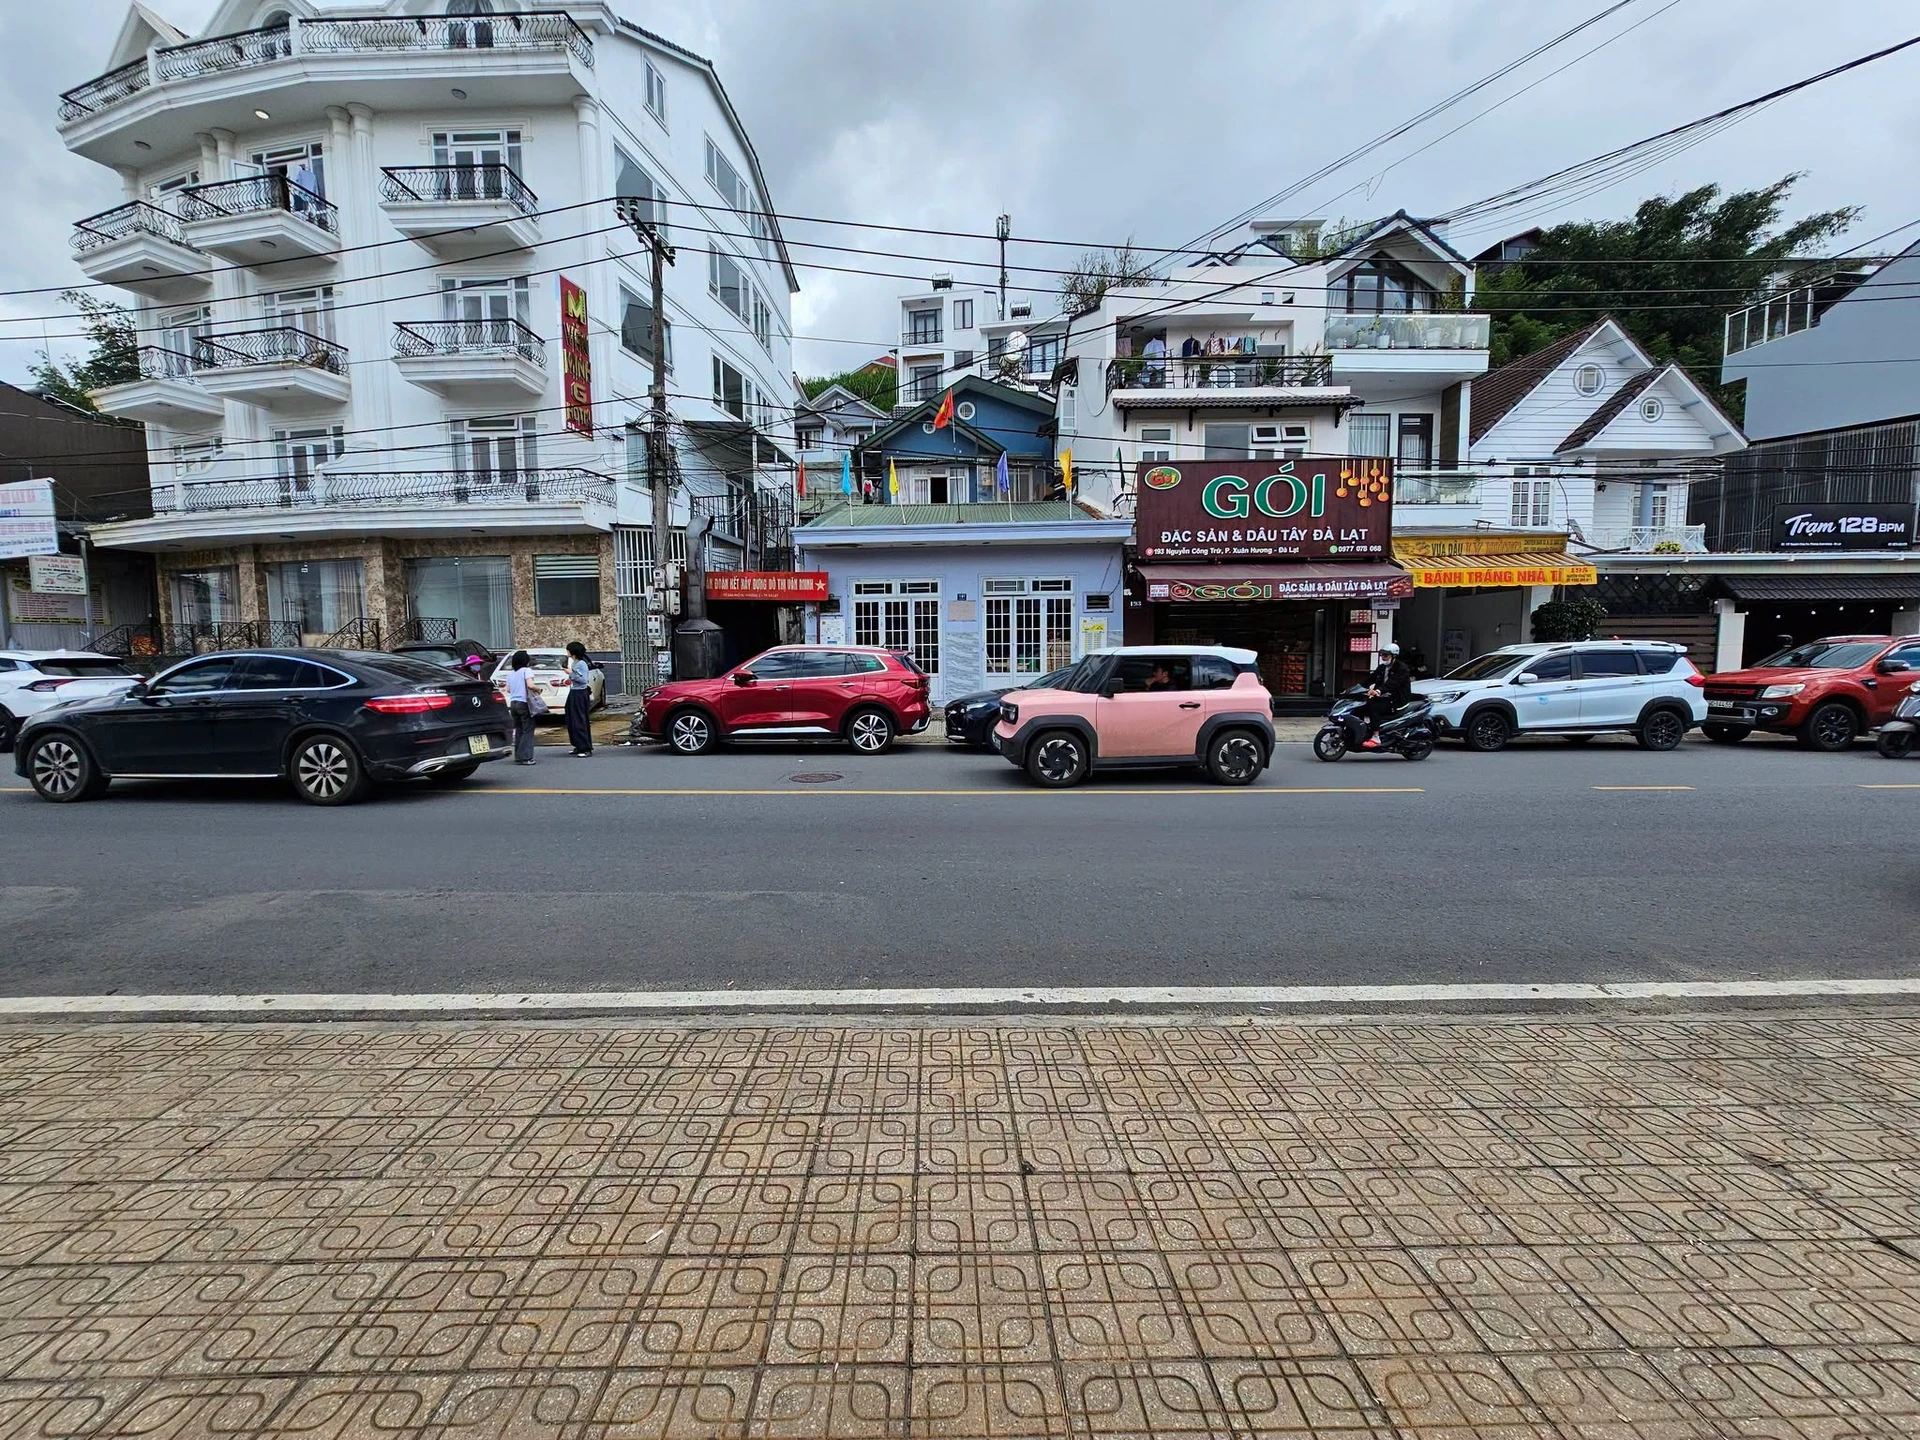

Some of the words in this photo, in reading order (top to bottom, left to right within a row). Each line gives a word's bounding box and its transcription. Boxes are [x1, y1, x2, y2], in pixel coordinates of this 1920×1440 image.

[567, 289, 587, 324] M
[571, 381, 587, 403] G
[1202, 461, 1326, 519] GÓI
[1784, 513, 1836, 536] Trạm
[1838, 517, 1878, 533] 128
[1878, 523, 1905, 533] BPM
[1161, 528, 1192, 546] ĐẶC
[1196, 527, 1228, 543] SẢN
[1232, 530, 1242, 541] &
[1246, 526, 1277, 542] DÂU
[1281, 526, 1307, 541] TÂY
[1312, 526, 1334, 541] ĐÀ
[1340, 528, 1369, 545] LẠT
[1166, 547, 1190, 556] Nguyễn
[1191, 548, 1208, 556] Công
[1250, 547, 1272, 555] Hương
[1288, 547, 1299, 555] Lạt
[714, 576, 729, 590] ĐOÀN
[729, 575, 739, 590] KẾT
[1517, 568, 1546, 582] NHÀ
[1194, 580, 1271, 599] GÓI
[1279, 582, 1297, 594] ĐẶC
[1299, 581, 1315, 592] SẢN
[1317, 583, 1323, 591] &
[1325, 581, 1342, 591] DÂU
[1344, 580, 1359, 591] TÂY
[1360, 579, 1372, 590] ĐÀ
[1374, 581, 1388, 592] LẠT
